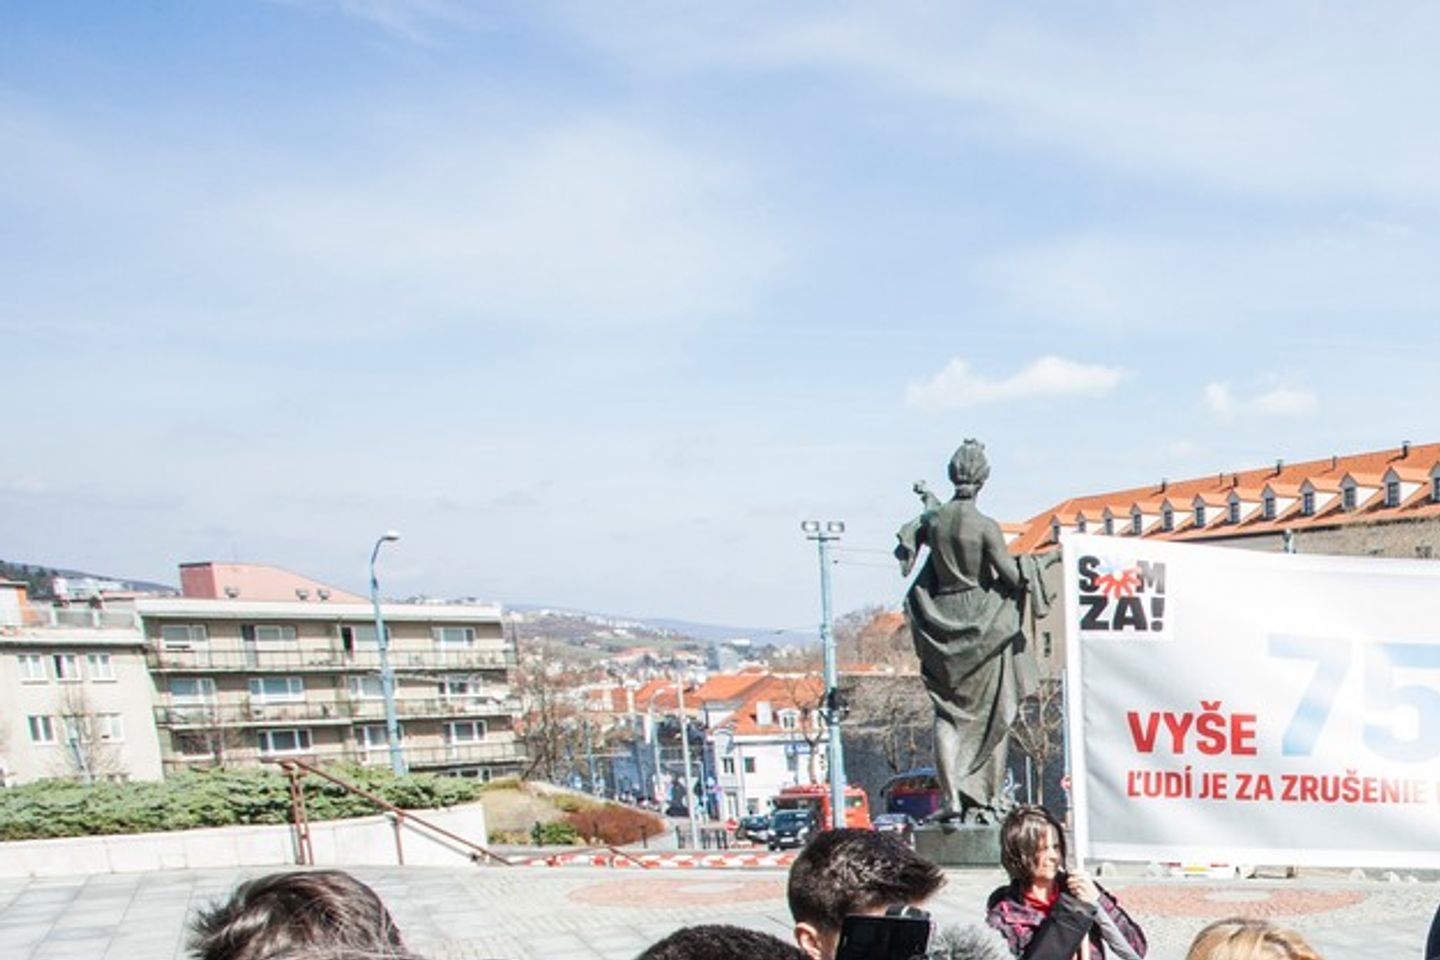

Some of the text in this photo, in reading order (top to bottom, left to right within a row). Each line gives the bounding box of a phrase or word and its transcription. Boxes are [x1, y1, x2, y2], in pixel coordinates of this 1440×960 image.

[1079, 556, 1165, 598] SM
[1079, 594, 1165, 632] ZA!
[1127, 701, 1257, 756] VYŠE
[1127, 766, 1192, 798] ĽUDÍ
[1199, 773, 1228, 800] JE
[1235, 774, 1274, 801] ZA
[1281, 769, 1428, 805] ZRUŠENIE
